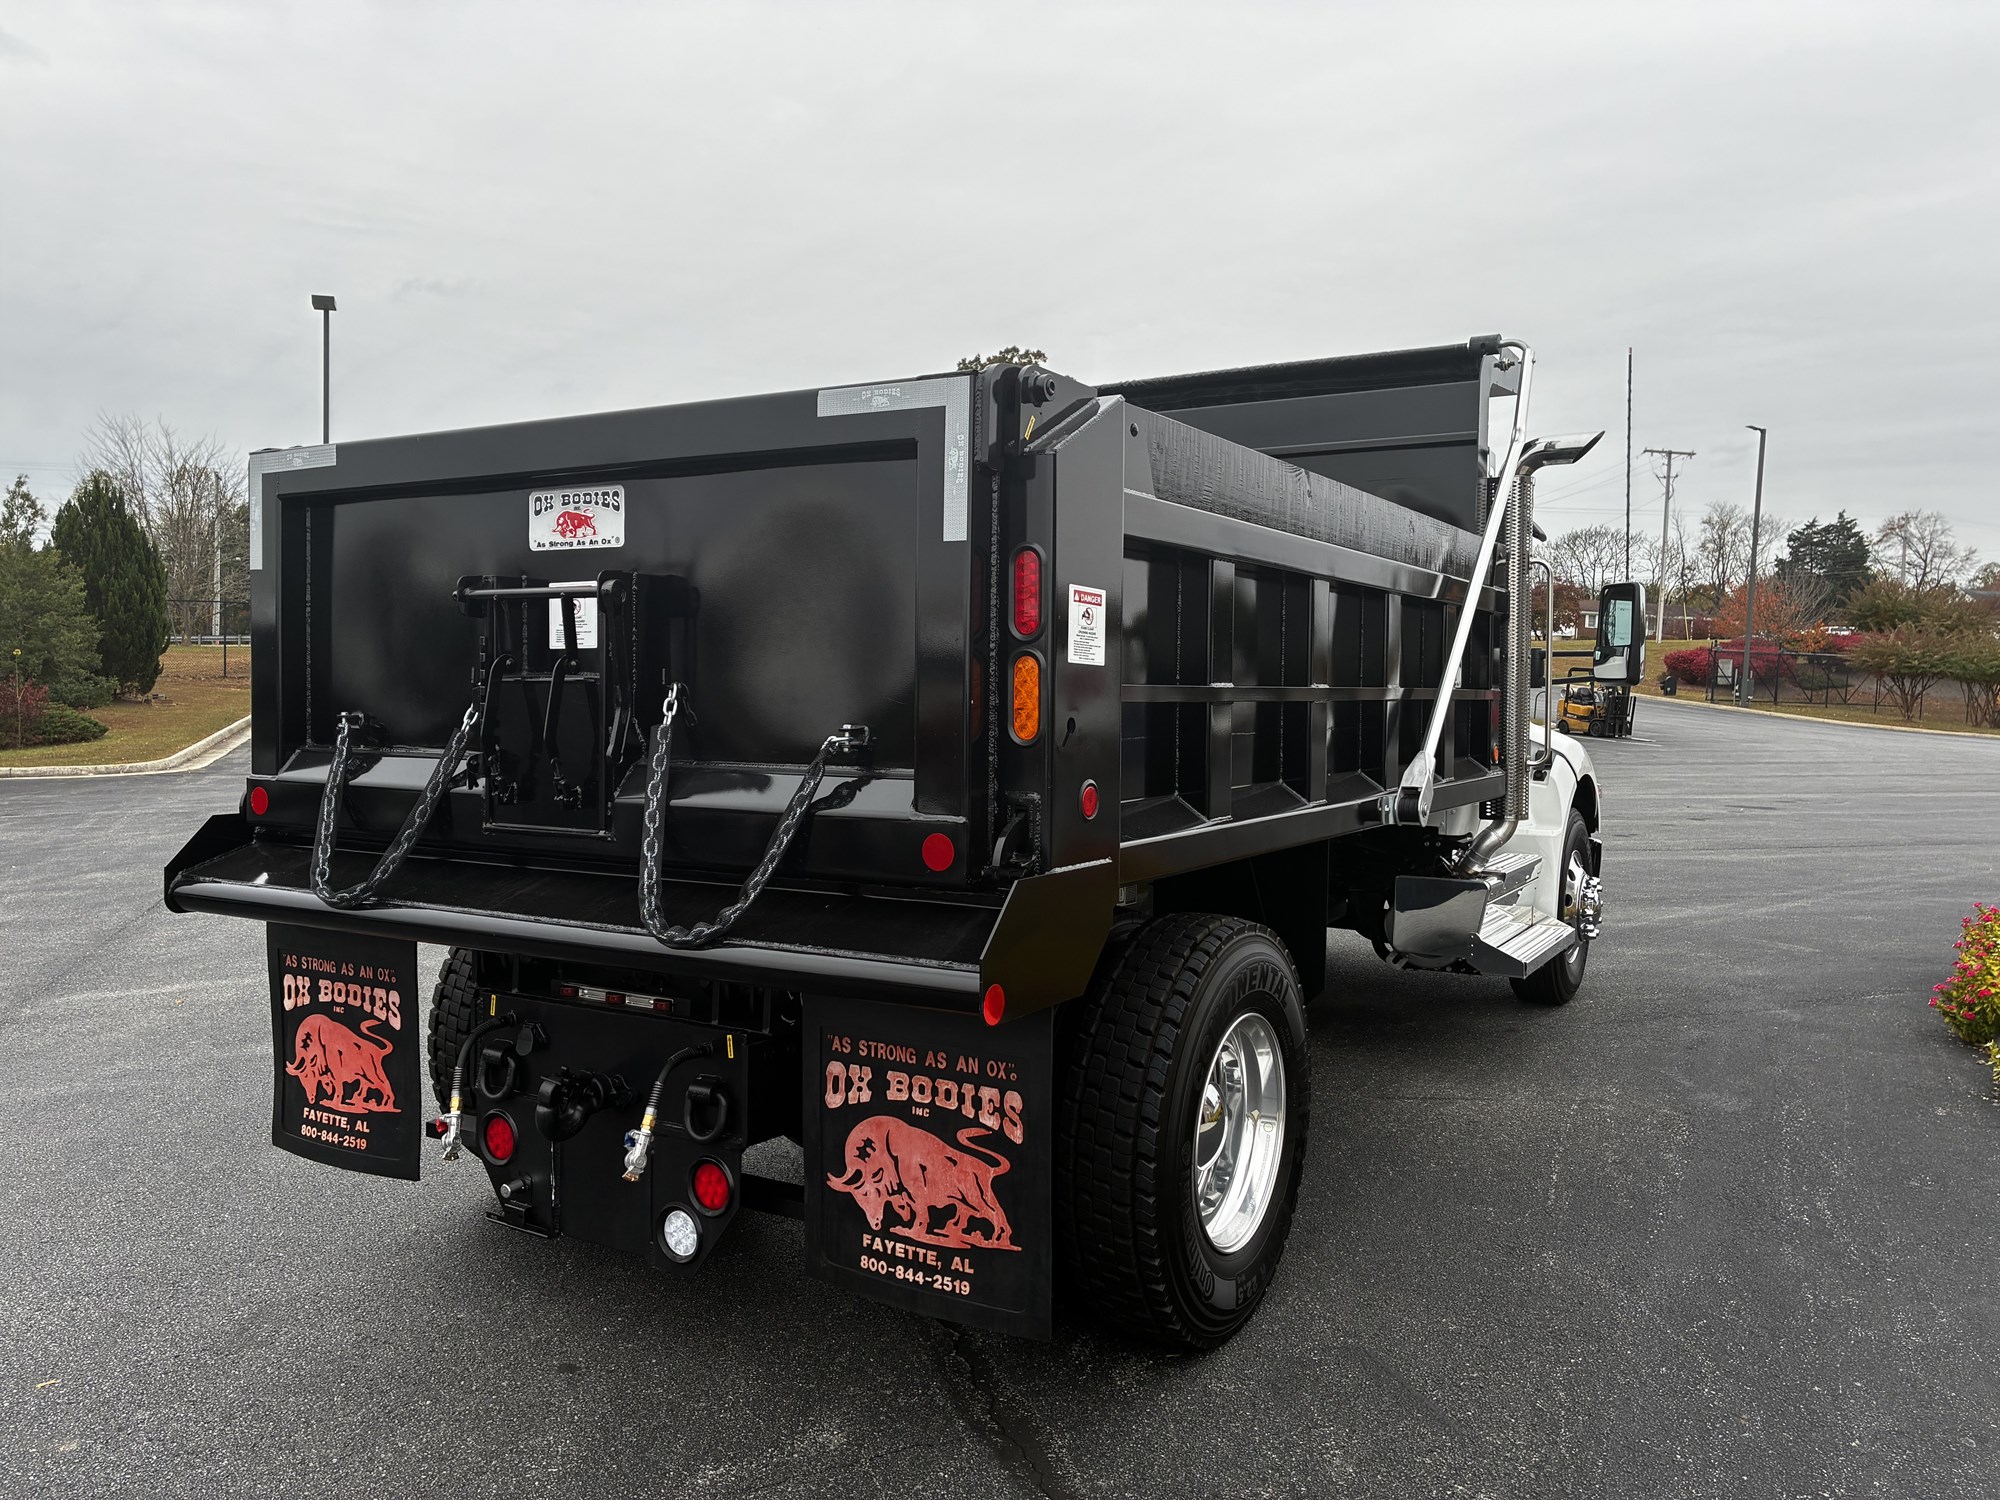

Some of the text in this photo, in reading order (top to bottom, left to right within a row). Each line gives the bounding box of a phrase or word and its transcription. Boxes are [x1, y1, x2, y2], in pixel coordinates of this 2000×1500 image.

[534, 490, 620, 516] OX BODIES
[549, 540, 573, 548] Strong
[1080, 593, 1102, 605] DANGER
[302, 956, 336, 973] STRONG
[341, 963, 355, 976] AS
[360, 966, 373, 979] AN
[283, 973, 401, 1031] OX BODIES
[333, 1006, 344, 1014] INC
[859, 1040, 916, 1064] STRONG
[925, 1051, 947, 1070] AS
[956, 1055, 978, 1074] AN
[825, 1061, 1023, 1145] OX BODIES
[912, 1106, 930, 1117] INC
[303, 1107, 370, 1133] FAYETTE, AL
[301, 1125, 367, 1149] 800-844-2519
[862, 1233, 974, 1275] FAYETTE, AL
[860, 1254, 971, 1295] 800-844-2519
